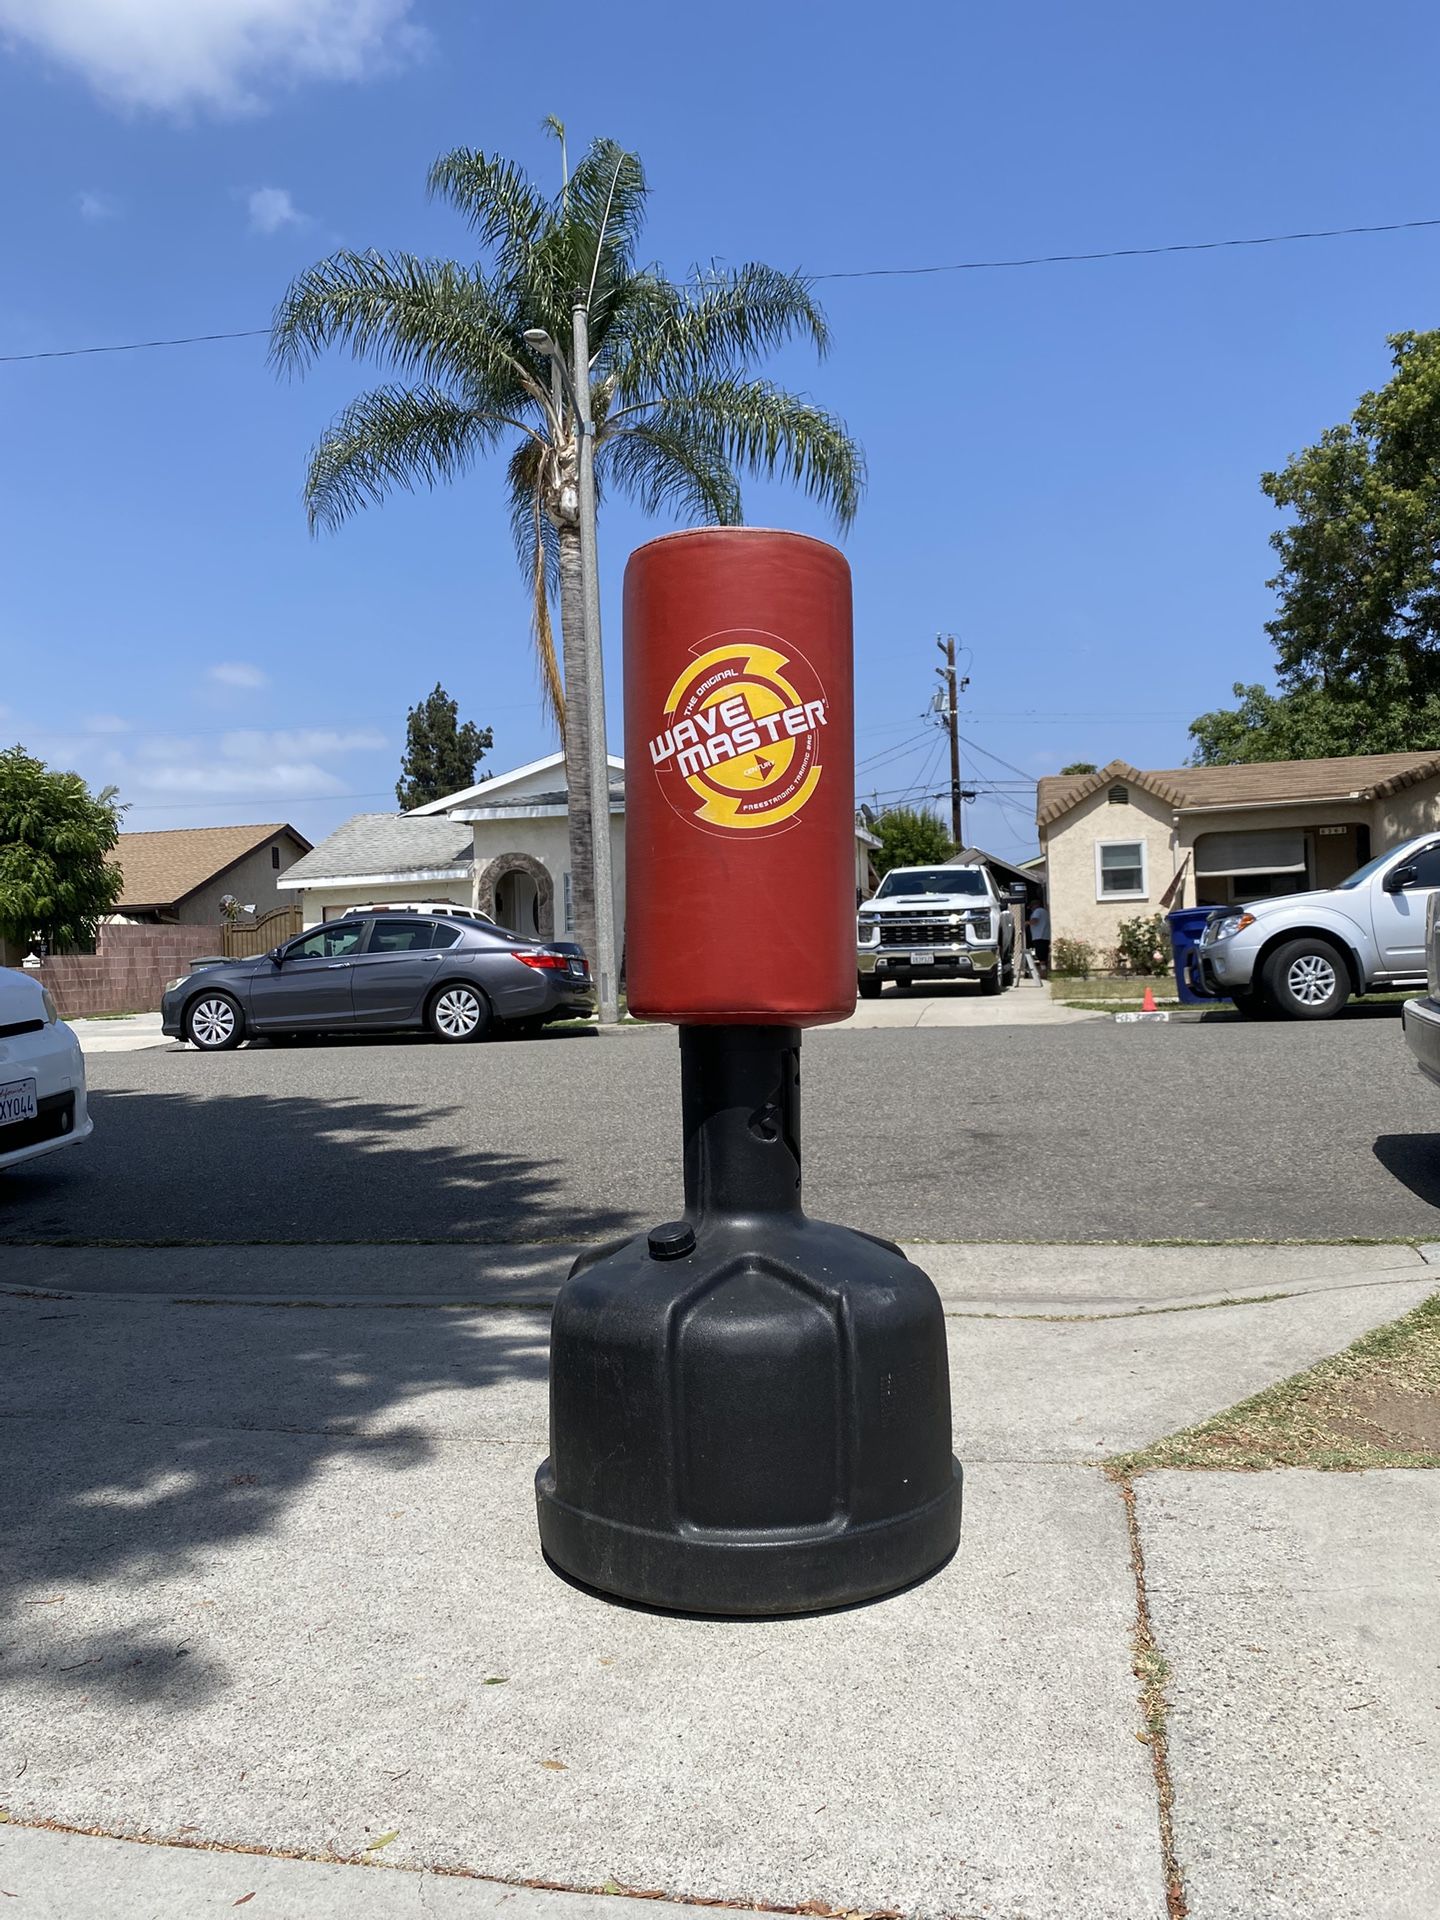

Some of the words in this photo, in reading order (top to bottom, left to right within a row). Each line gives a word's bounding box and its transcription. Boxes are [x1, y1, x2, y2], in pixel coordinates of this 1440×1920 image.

[684, 695, 699, 716] THE
[696, 668, 739, 696] ORIGINAL
[648, 695, 750, 765] WAVE
[742, 784, 795, 811] FREESTANDING
[793, 752, 810, 784] TRAINING
[743, 759, 776, 777] CENTURY
